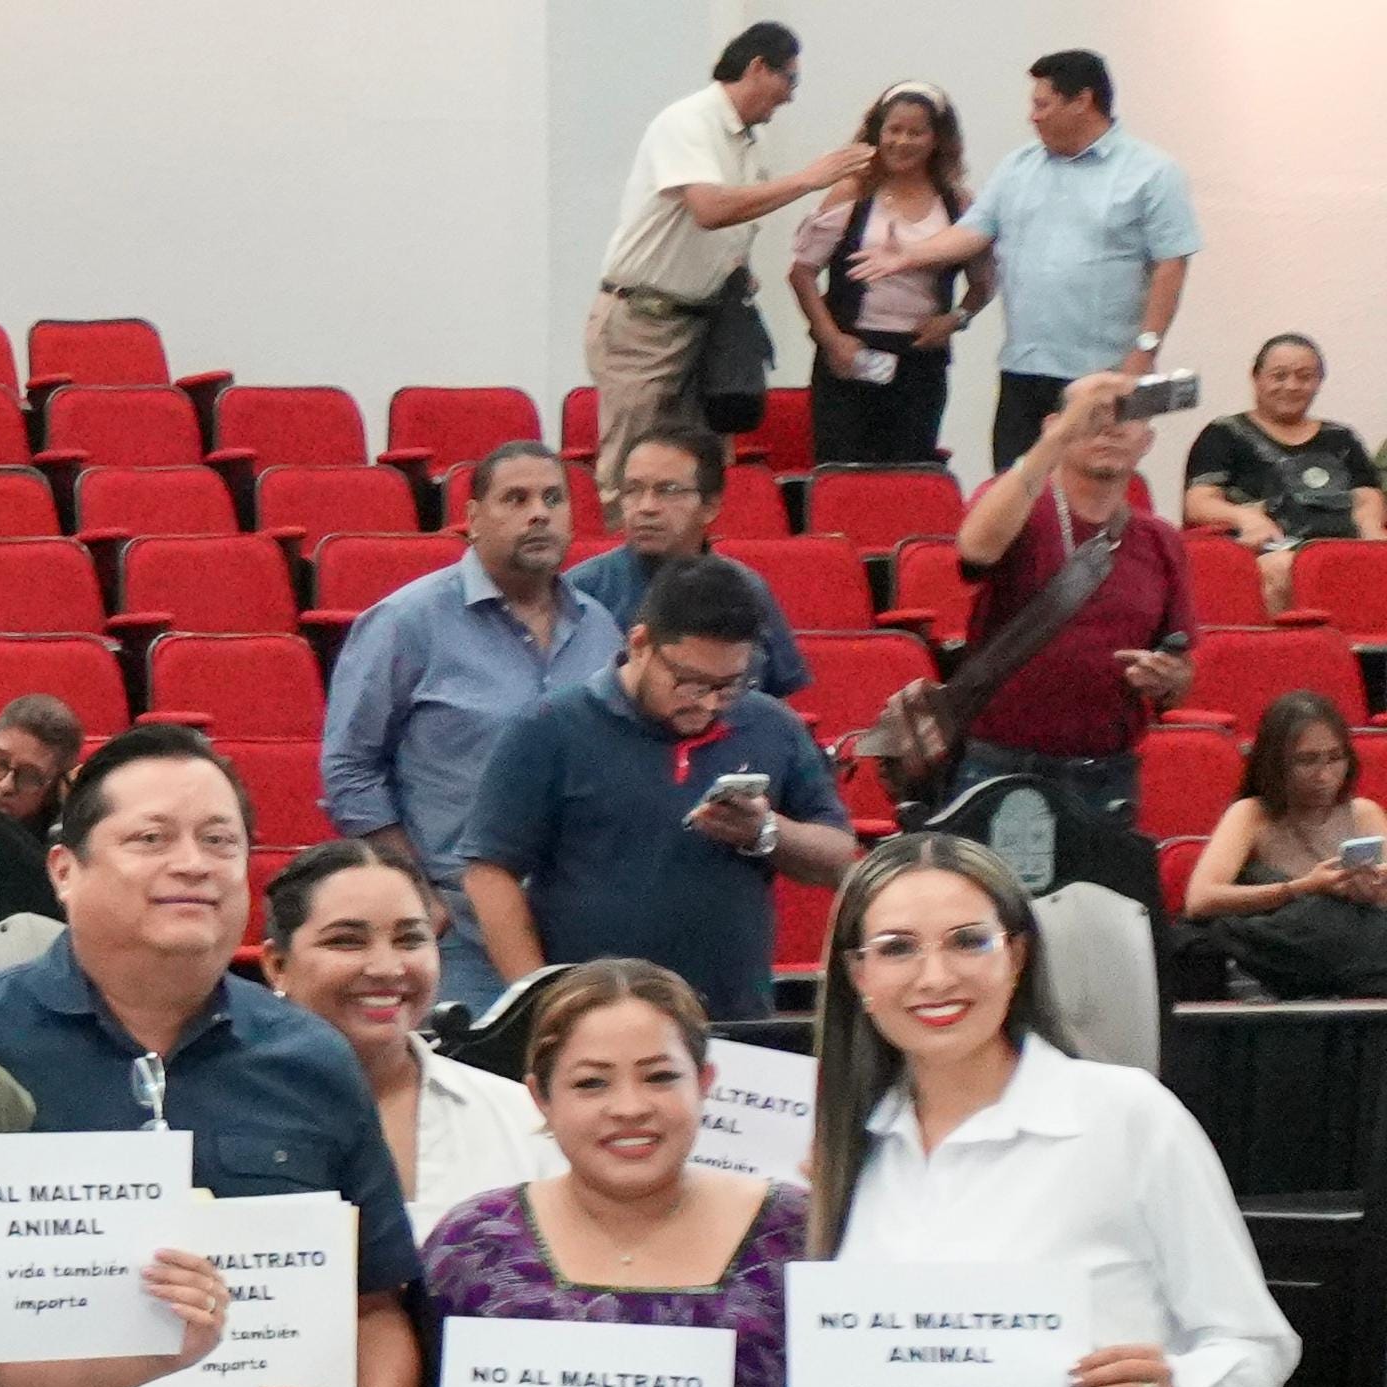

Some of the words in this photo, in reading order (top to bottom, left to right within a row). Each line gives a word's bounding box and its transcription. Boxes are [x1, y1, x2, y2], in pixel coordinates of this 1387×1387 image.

[709, 1085, 811, 1117] LTRATO
[29, 1183, 162, 1202] MALTRATO
[7, 1218, 105, 1237] ANIMAL
[7, 1263, 46, 1279] vida
[53, 1262, 129, 1277] también
[227, 1285, 275, 1304] MAL
[14, 1296, 88, 1316] importa
[819, 1312, 860, 1330] NO
[868, 1312, 905, 1330] AL
[914, 1312, 1062, 1331] MALTRATO
[231, 1324, 300, 1341] también
[887, 1346, 994, 1364] ANIMAL
[202, 1358, 268, 1377] importa
[472, 1366, 509, 1384] NO
[517, 1369, 552, 1386] AL
